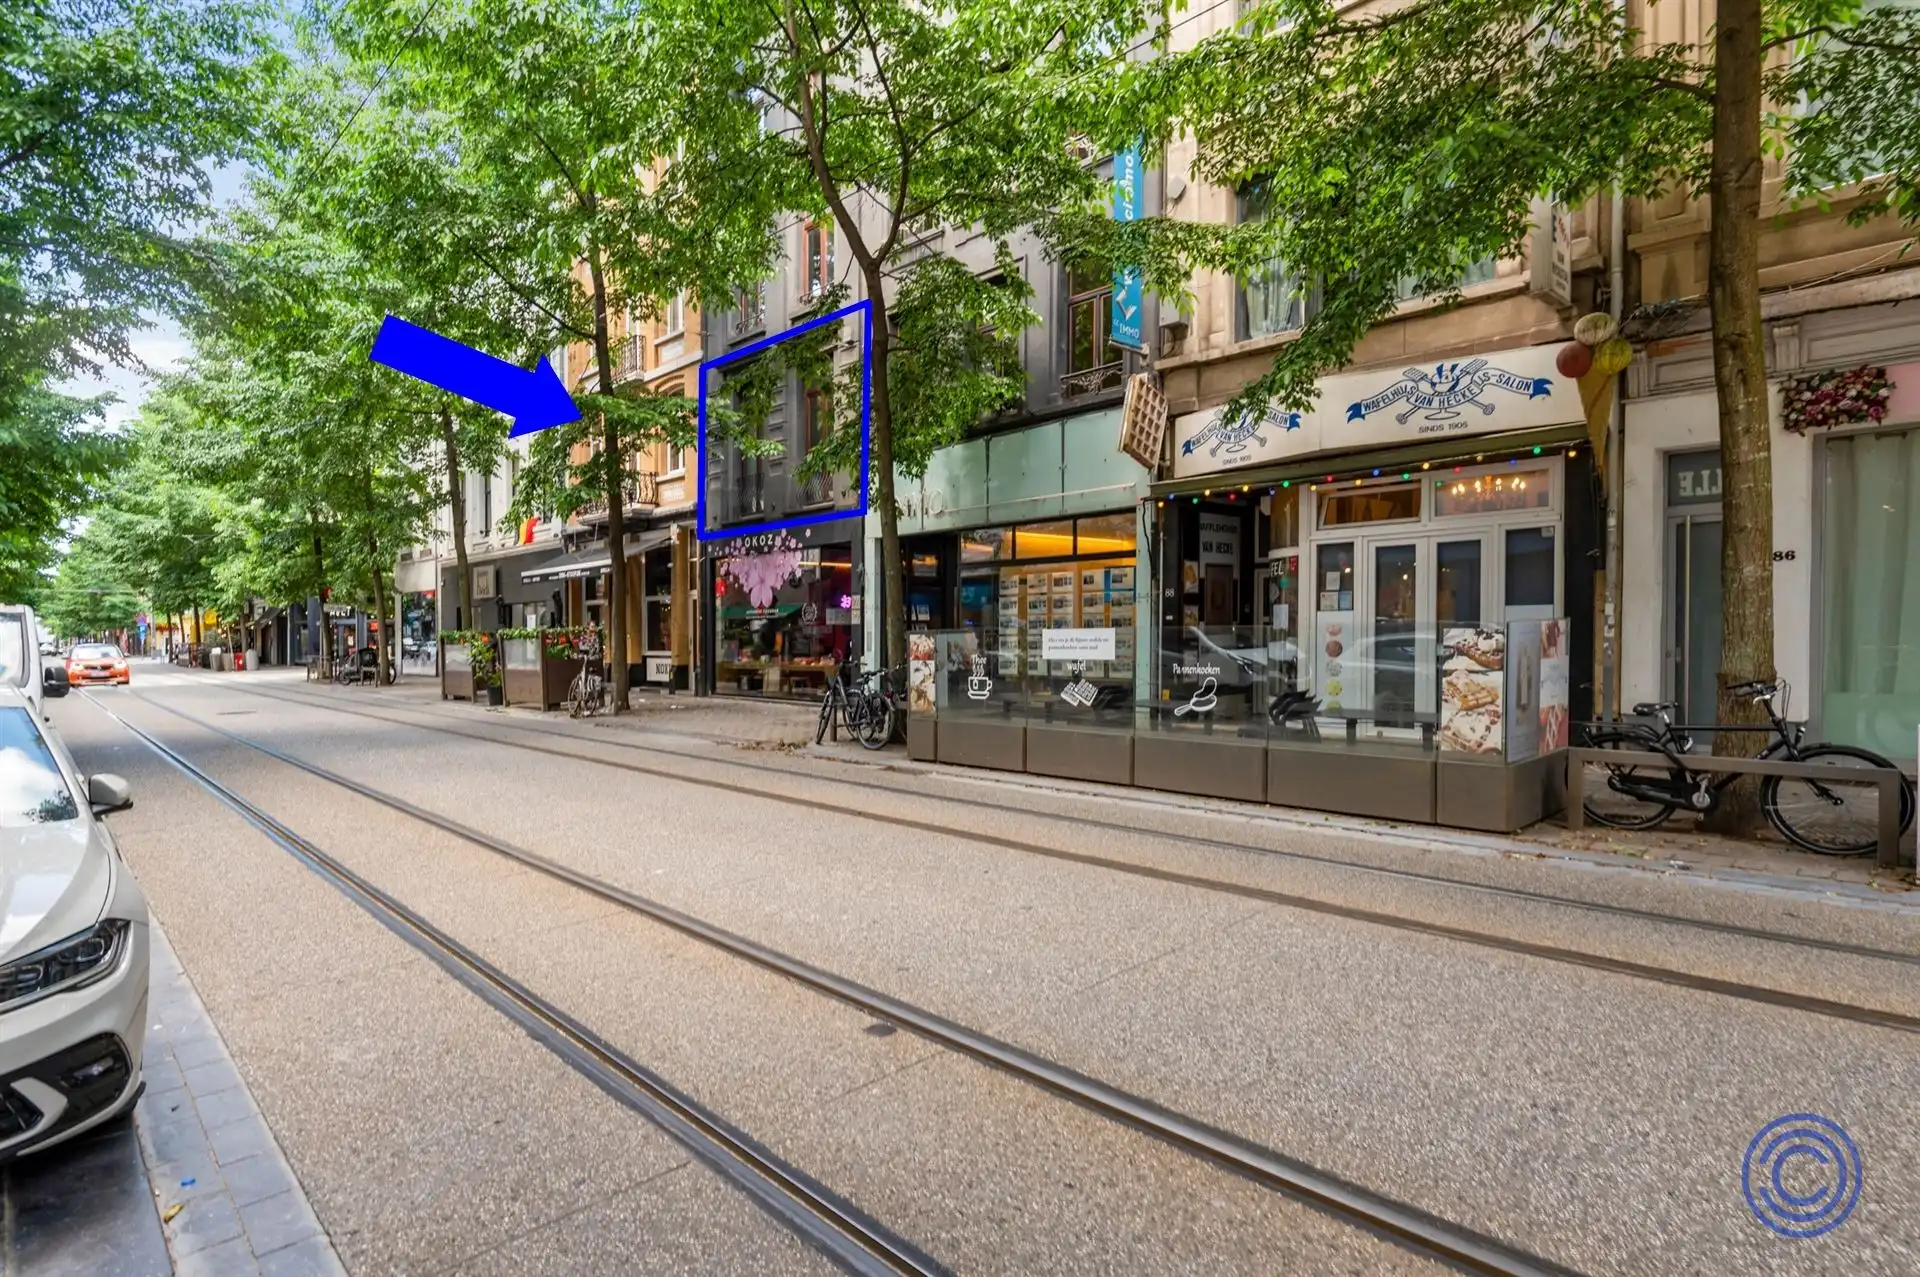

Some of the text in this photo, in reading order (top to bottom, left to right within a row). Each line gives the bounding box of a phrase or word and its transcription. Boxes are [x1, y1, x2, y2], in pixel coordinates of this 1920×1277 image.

[1119, 323, 1139, 339] IMMO
[1362, 383, 1417, 412] WAFELHUIS
[1414, 395, 1433, 407] VAN
[1438, 386, 1476, 408] HECKE
[1418, 424, 1445, 434] SINDS
[1220, 430, 1232, 442] VAN
[1772, 550, 1796, 561] 86
[1165, 588, 1175, 598] 88
[655, 663, 671, 675] NOK
[1066, 657, 1086, 674] wafel
